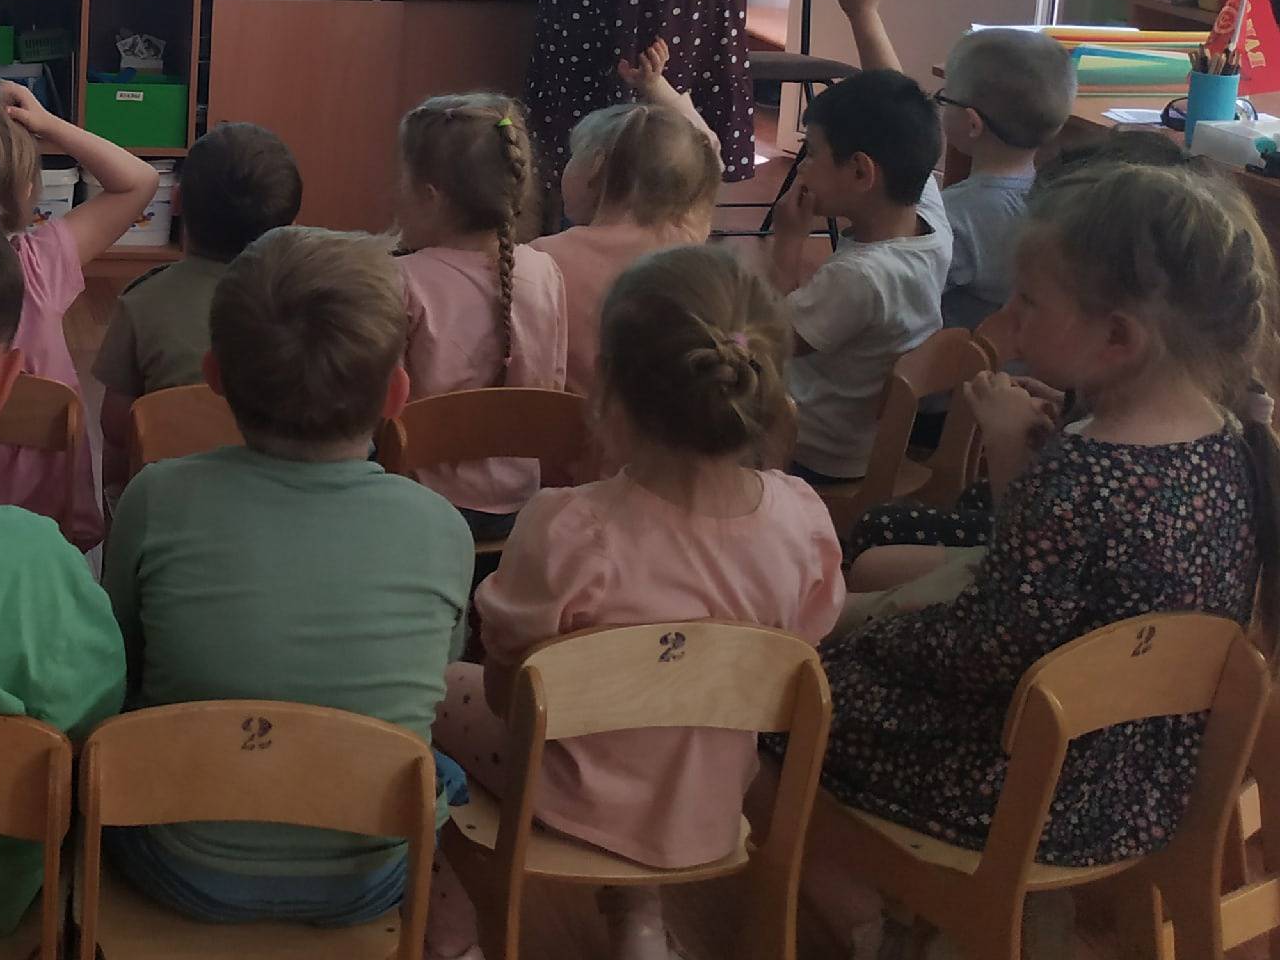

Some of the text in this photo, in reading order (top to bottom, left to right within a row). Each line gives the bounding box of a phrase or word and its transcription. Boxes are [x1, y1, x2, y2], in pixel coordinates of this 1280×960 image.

[657, 631, 686, 662] 2
[1131, 625, 1156, 657] 2
[242, 717, 273, 751] 2
